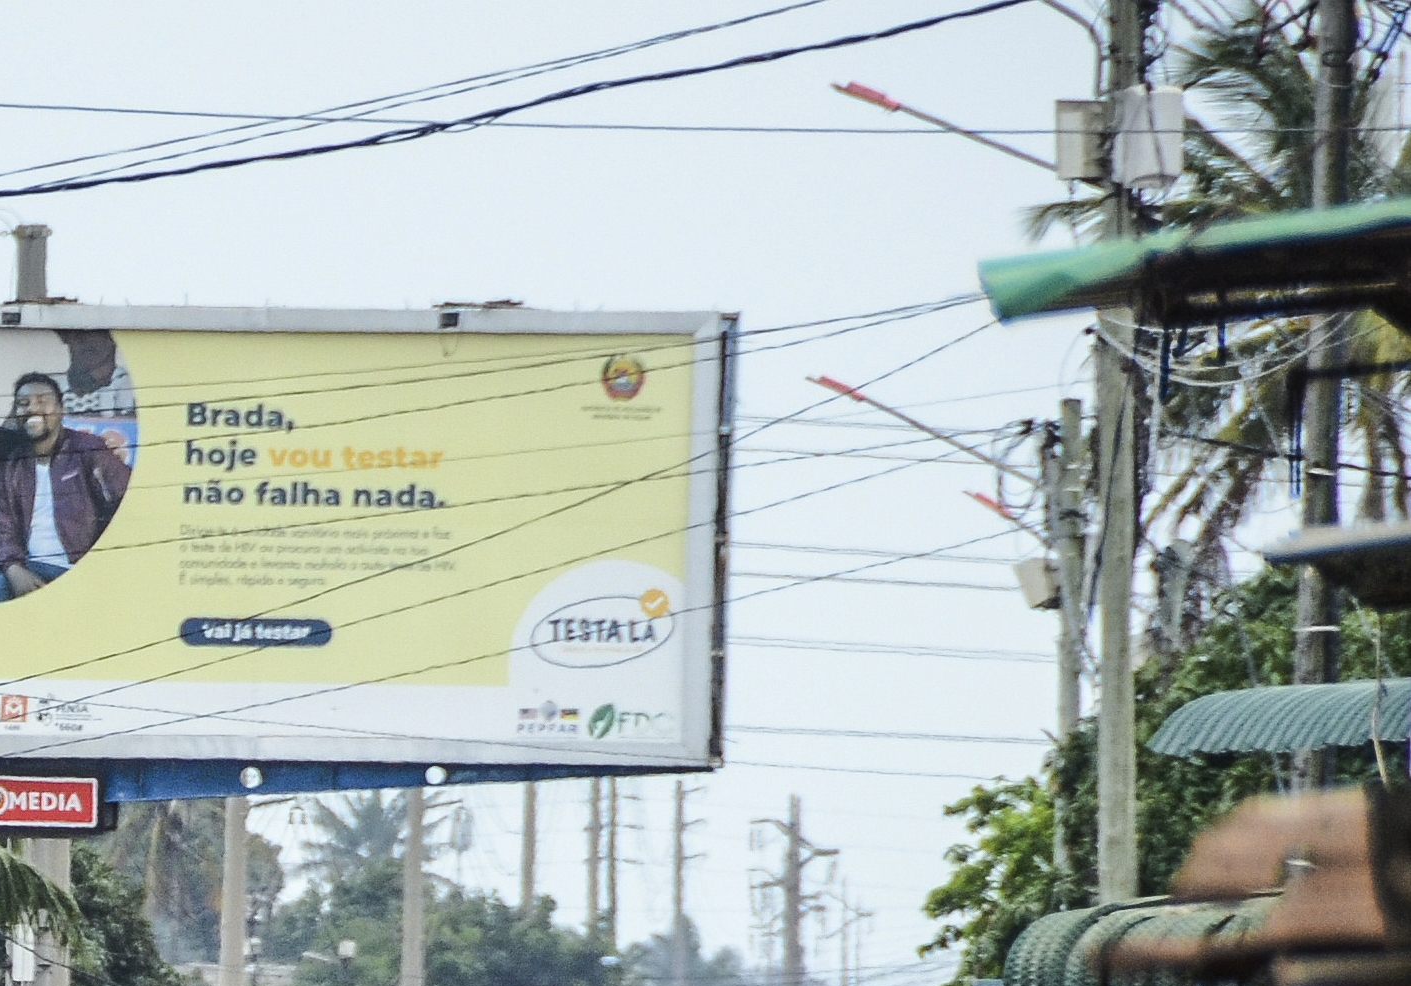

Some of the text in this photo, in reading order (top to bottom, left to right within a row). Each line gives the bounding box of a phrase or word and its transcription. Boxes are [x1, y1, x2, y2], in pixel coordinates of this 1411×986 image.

[186, 403, 294, 432] Brada,
[185, 440, 444, 471] hoje vou testar
[183, 480, 445, 509] não falha nada.
[255, 623, 311, 641] testar
[547, 618, 622, 643] TESTA
[7, 792, 83, 813] MEDIA
